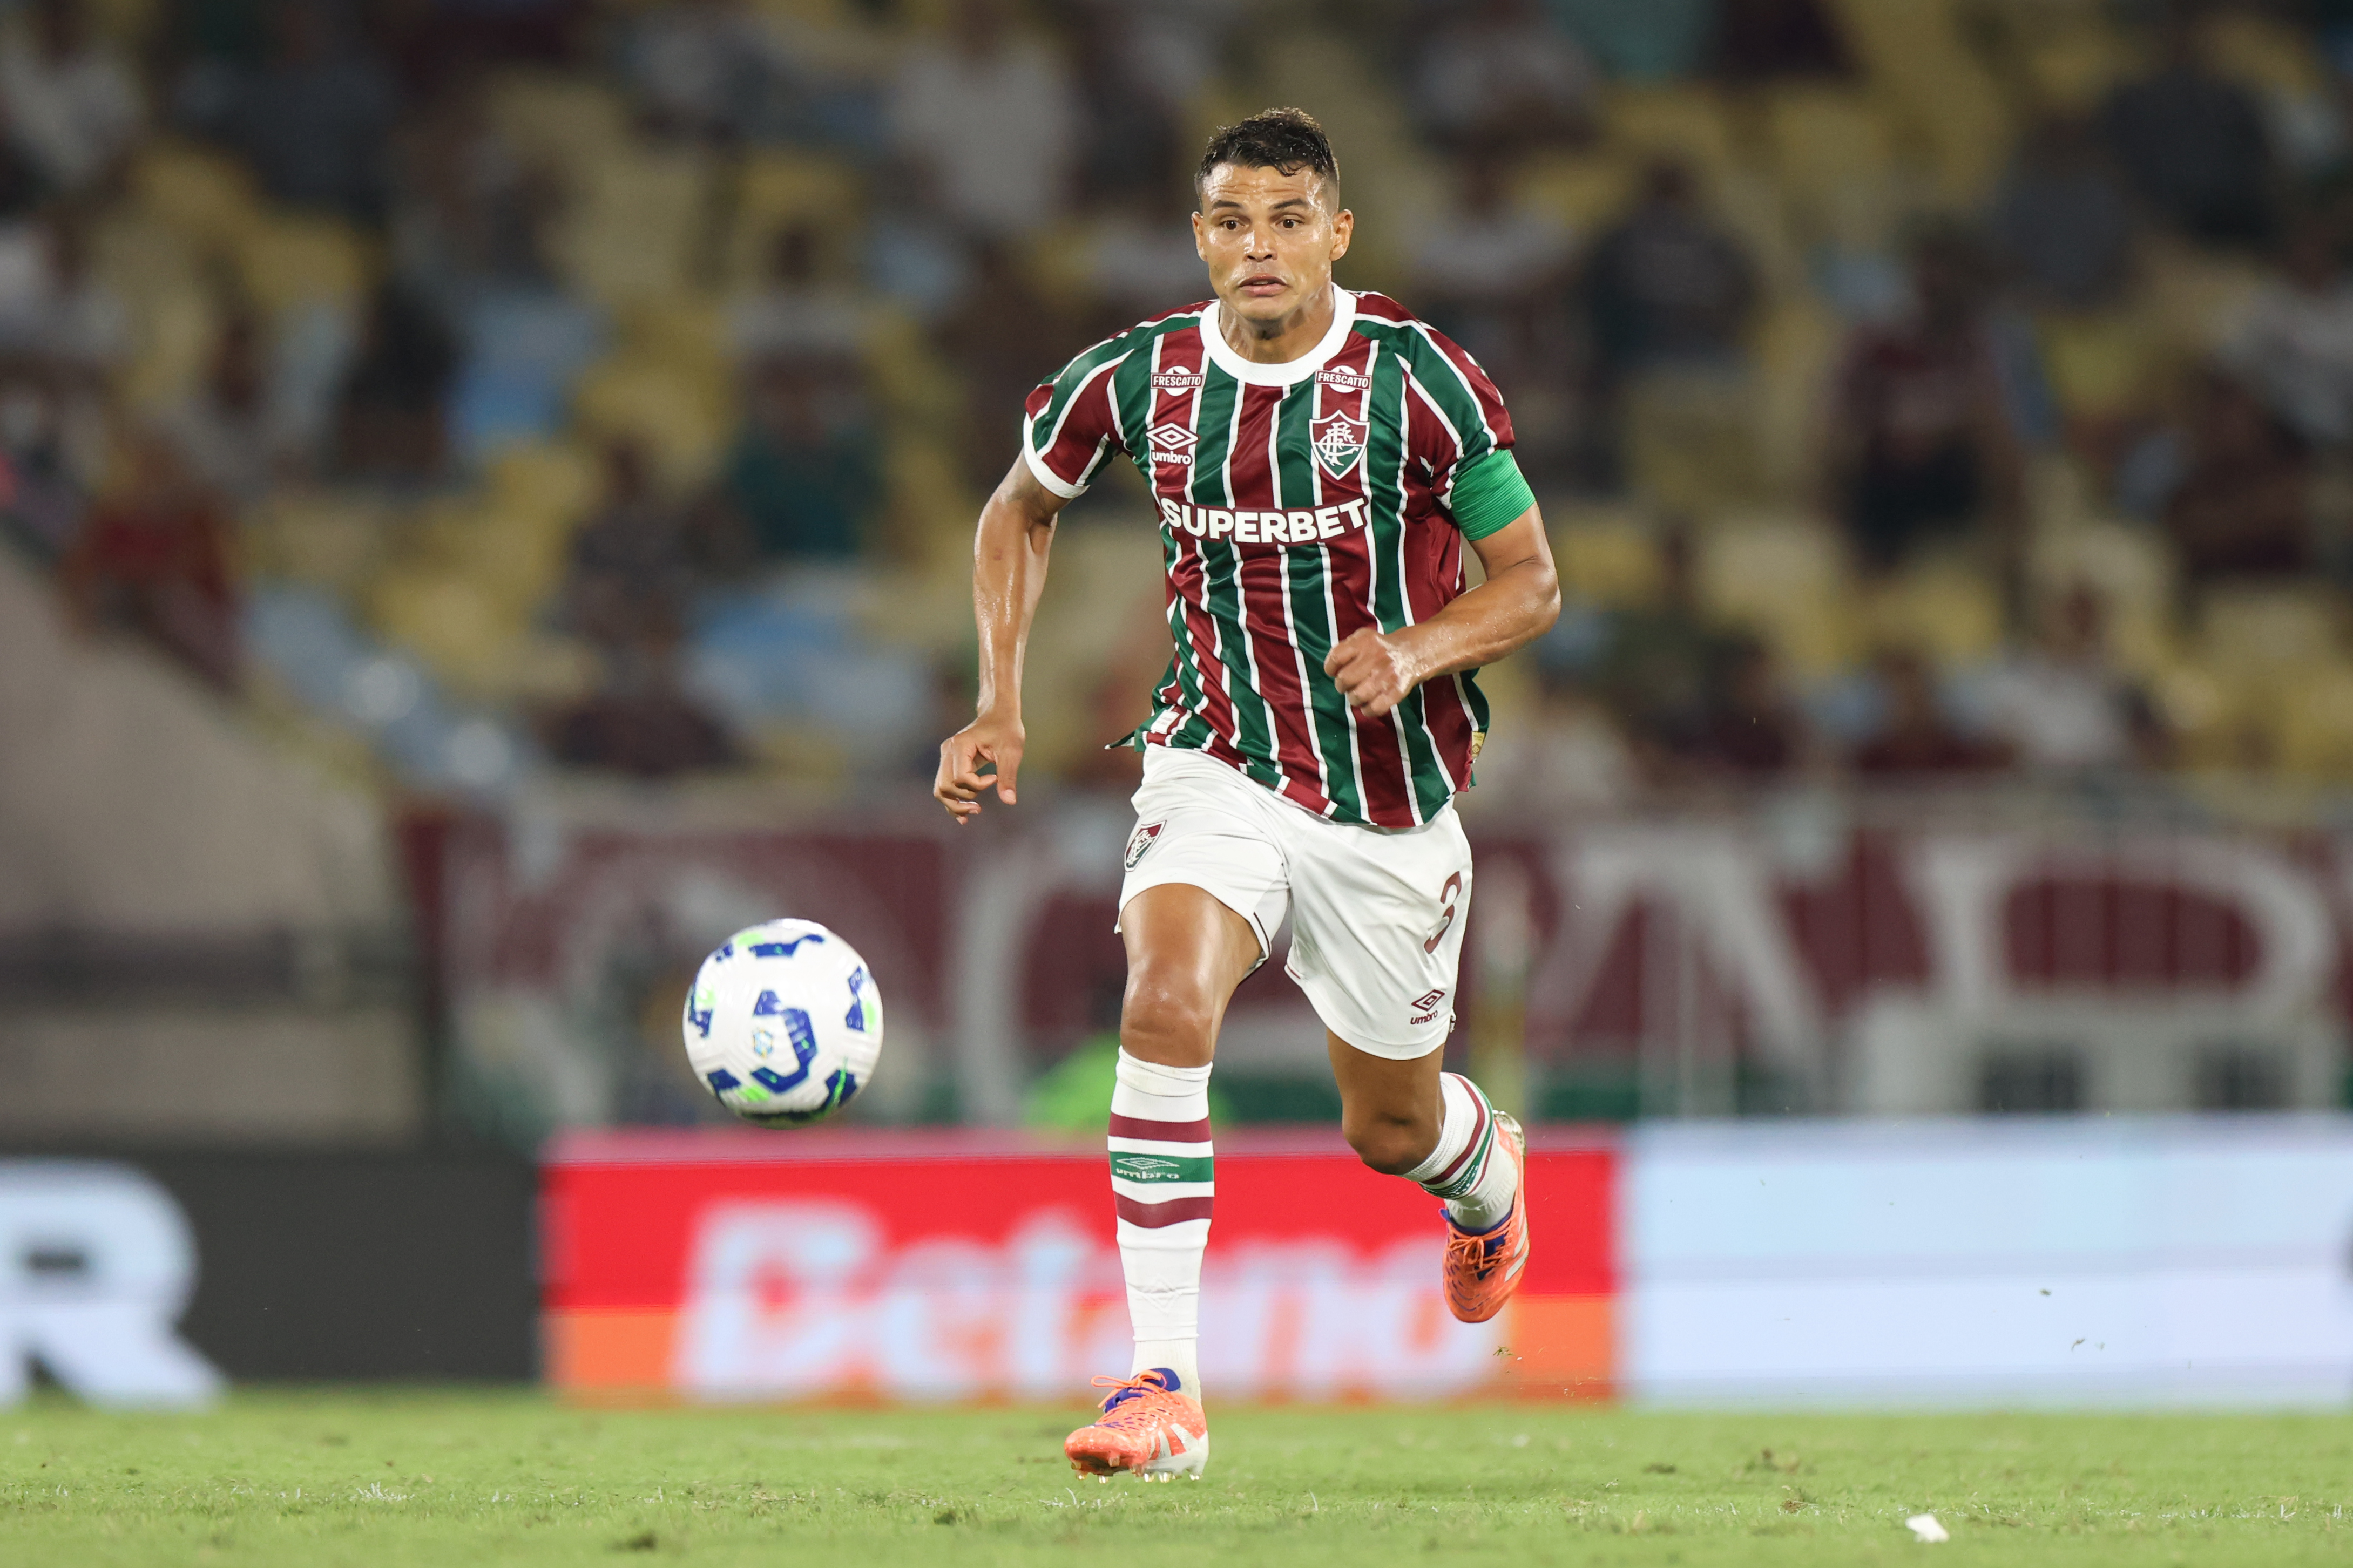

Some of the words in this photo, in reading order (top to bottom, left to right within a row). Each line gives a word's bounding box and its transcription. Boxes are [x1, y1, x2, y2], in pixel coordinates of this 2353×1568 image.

[1153, 376, 1201, 386] FRESCATTO
[1318, 372, 1369, 388] FRESCATTO
[1152, 451, 1192, 465] umbro
[1161, 498, 1365, 543] SUPERBET
[1424, 871, 1462, 954] 3
[1410, 1010, 1438, 1025] umbro
[1116, 1167, 1179, 1179] umbro
